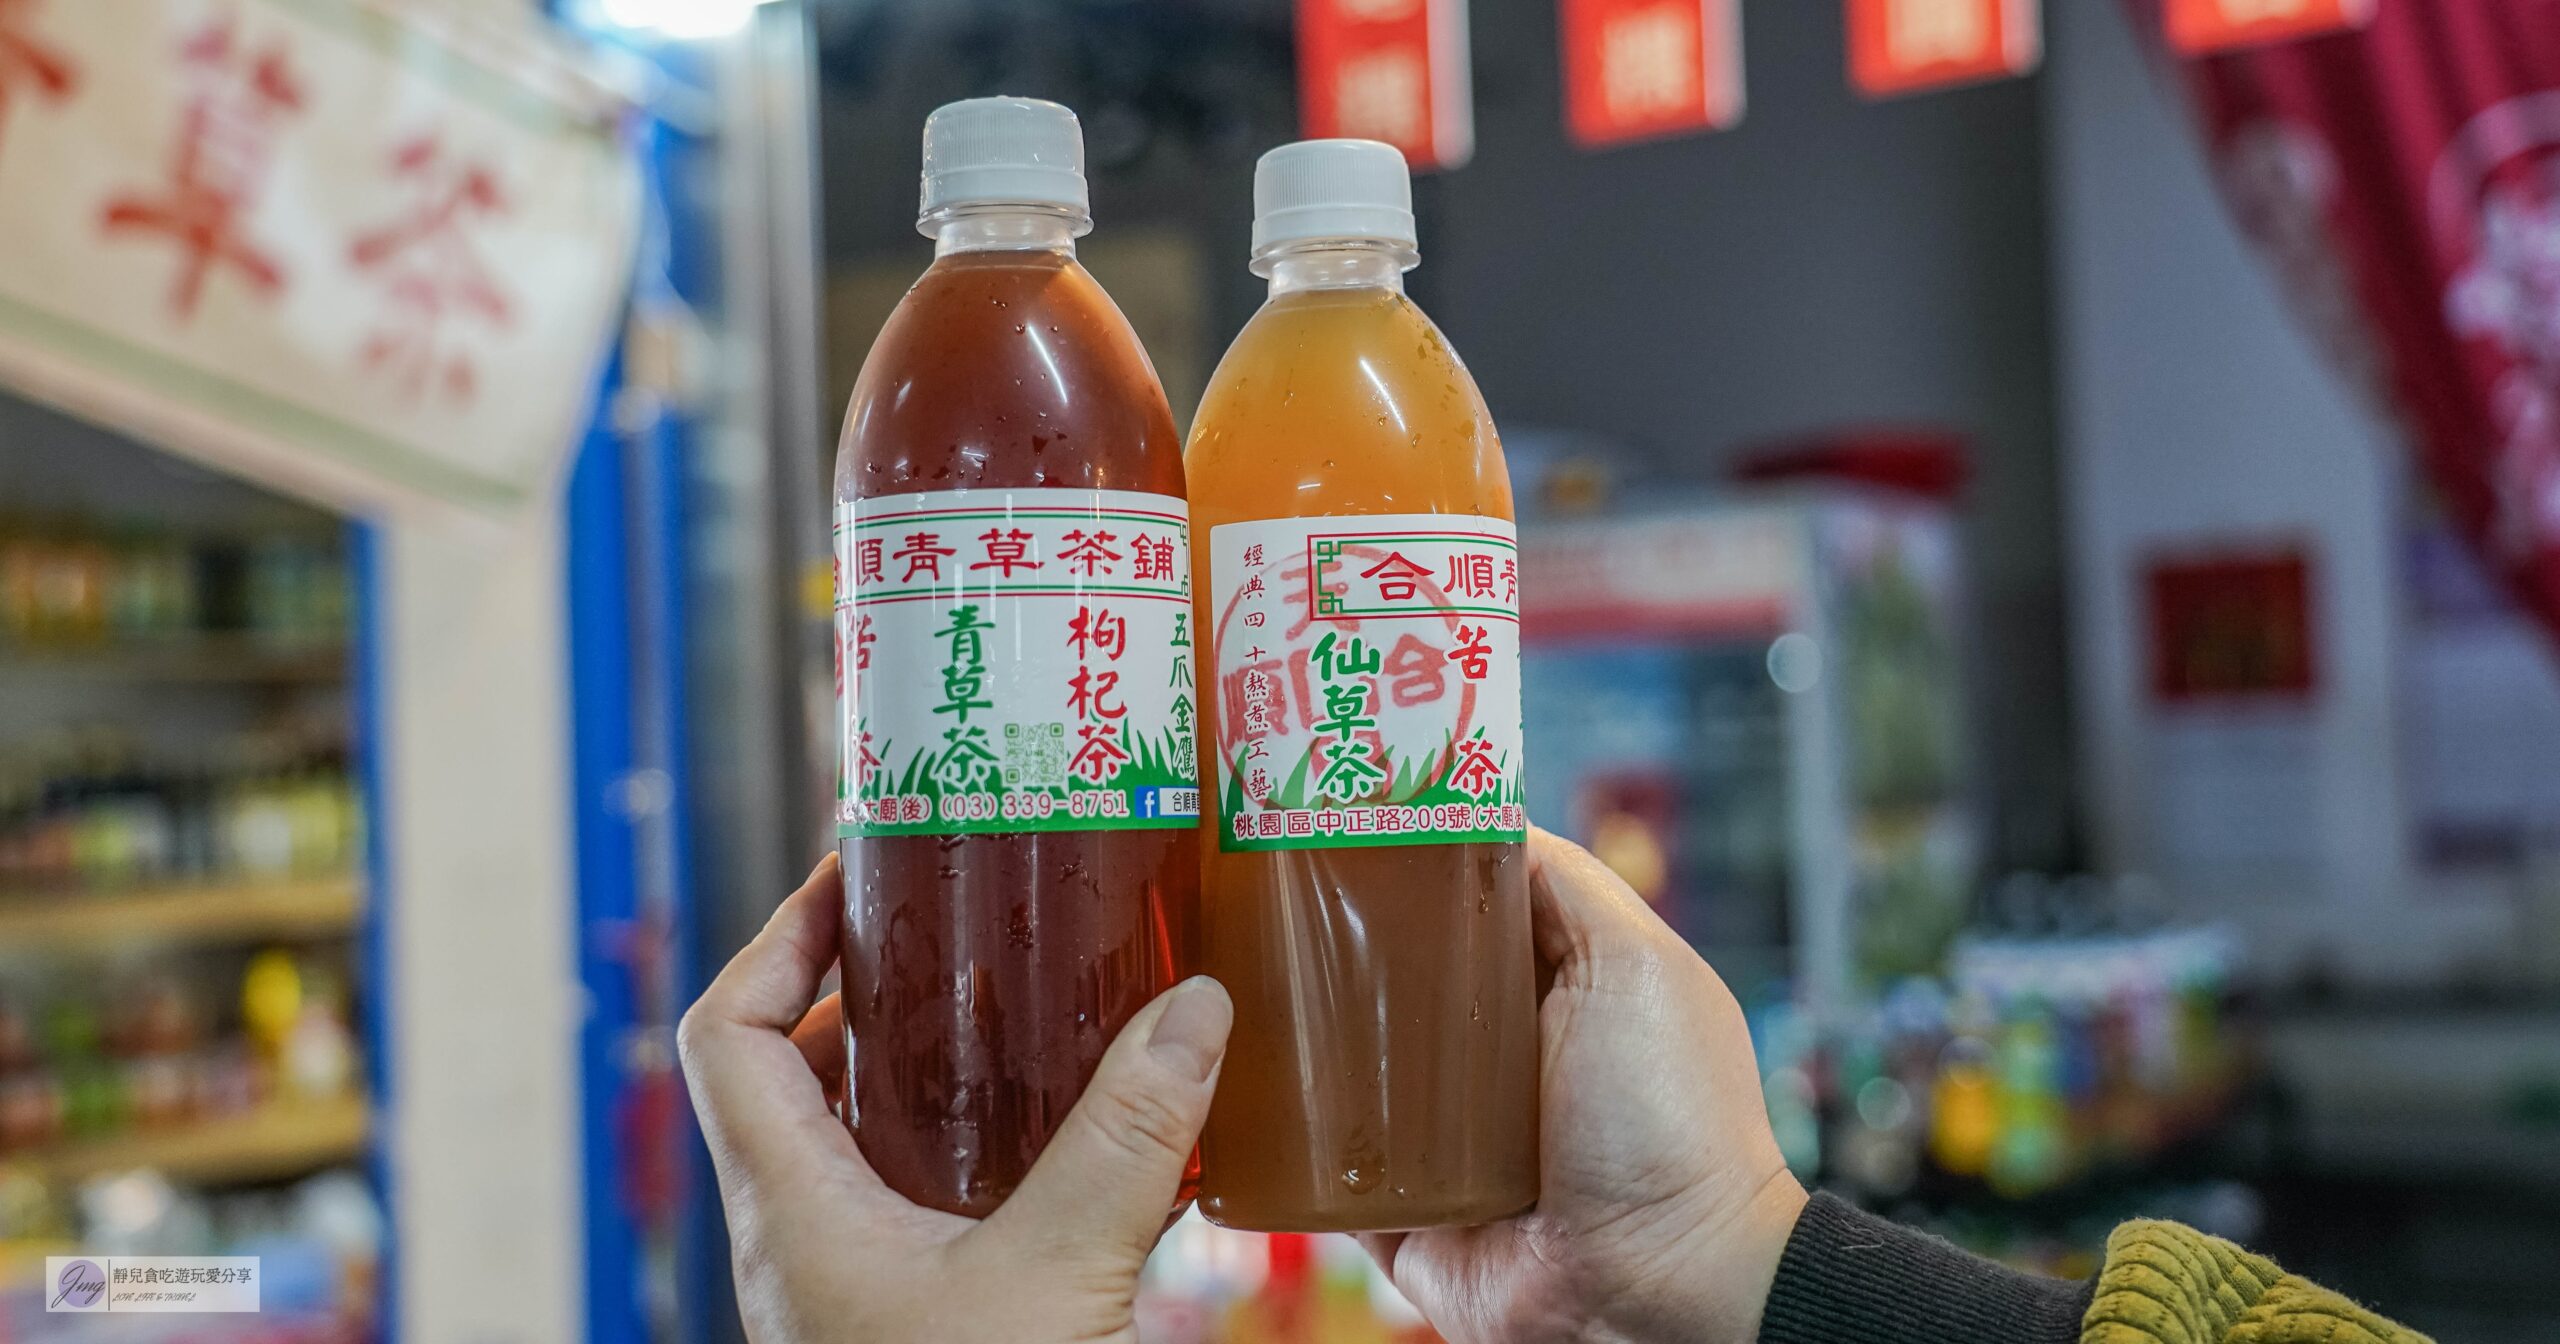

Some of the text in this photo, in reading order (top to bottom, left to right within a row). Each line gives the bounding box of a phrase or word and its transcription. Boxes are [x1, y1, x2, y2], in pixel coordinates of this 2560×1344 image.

[834, 527, 1174, 594] 順青草茶鋪
[932, 604, 1000, 783] 青草茶
[1066, 605, 1130, 781] 枸杞茶
[1311, 631, 1384, 798] 仙草茶
